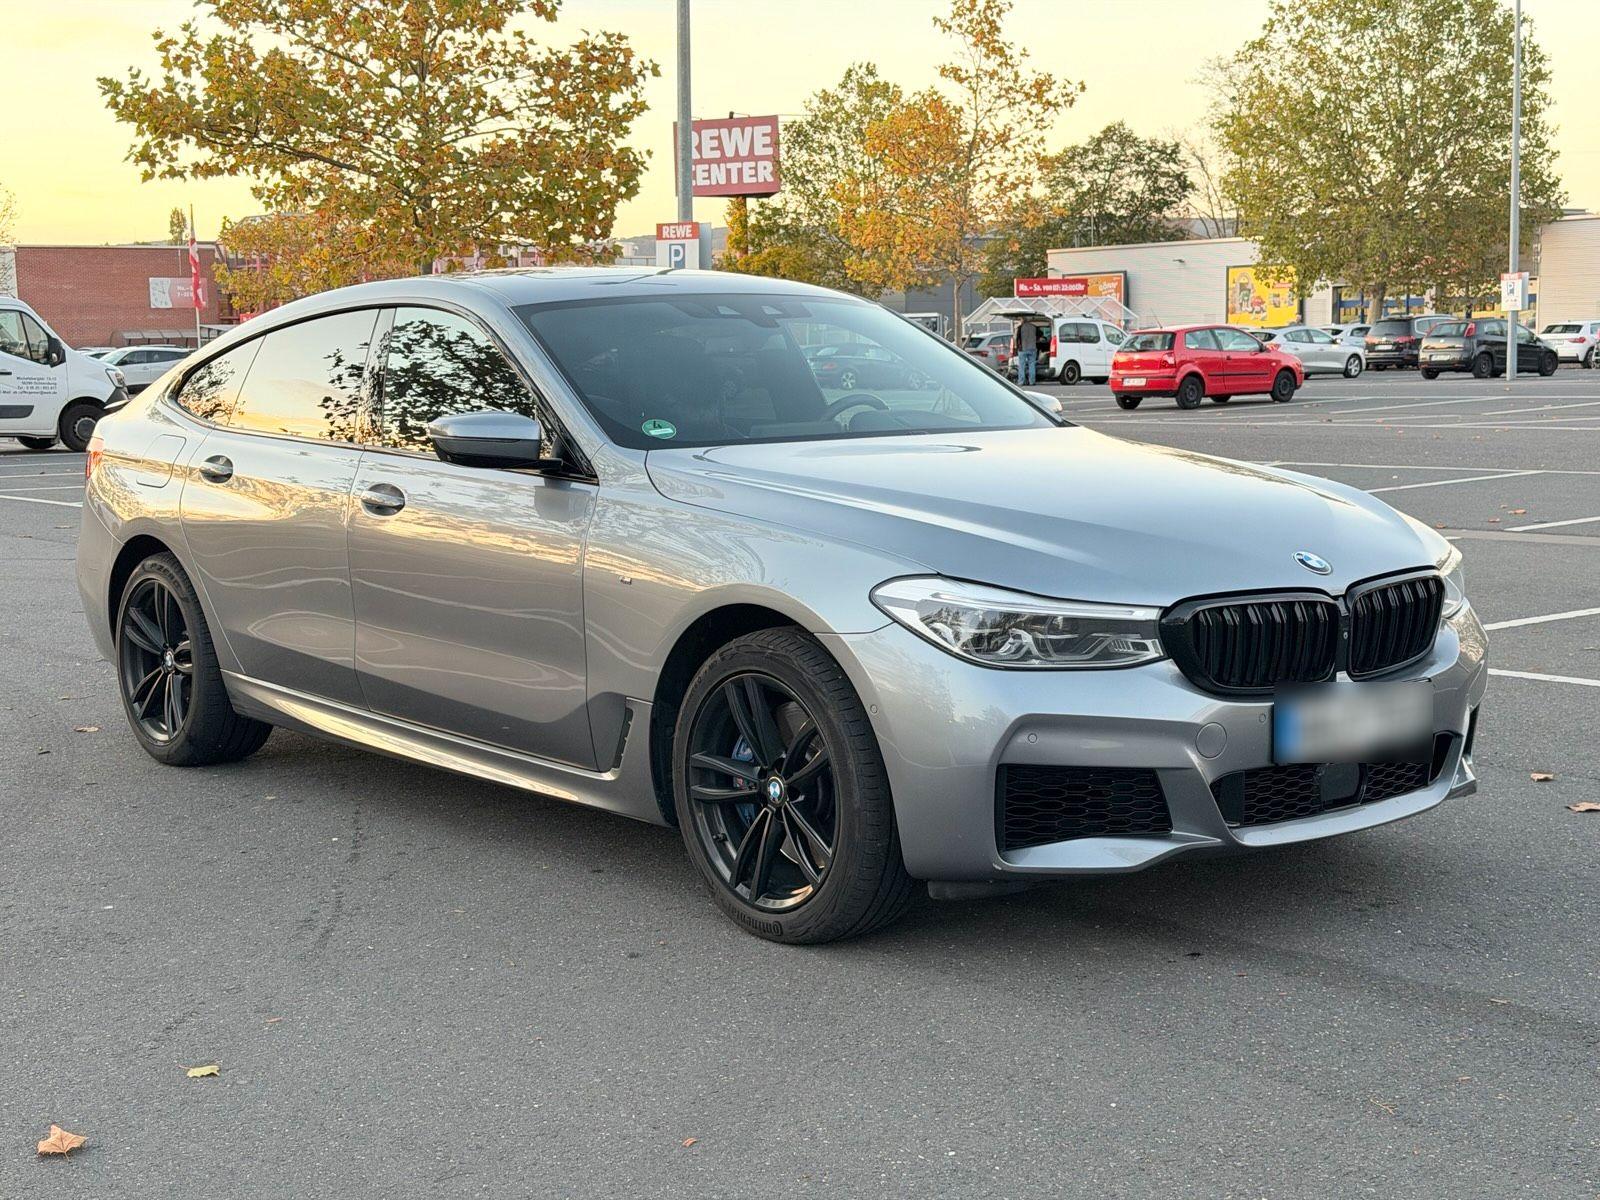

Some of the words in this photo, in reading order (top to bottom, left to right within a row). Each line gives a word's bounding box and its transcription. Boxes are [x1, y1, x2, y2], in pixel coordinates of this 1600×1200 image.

[691, 160, 774, 186] ENTER
[662, 225, 693, 239] REWE
[671, 244, 684, 268] P
